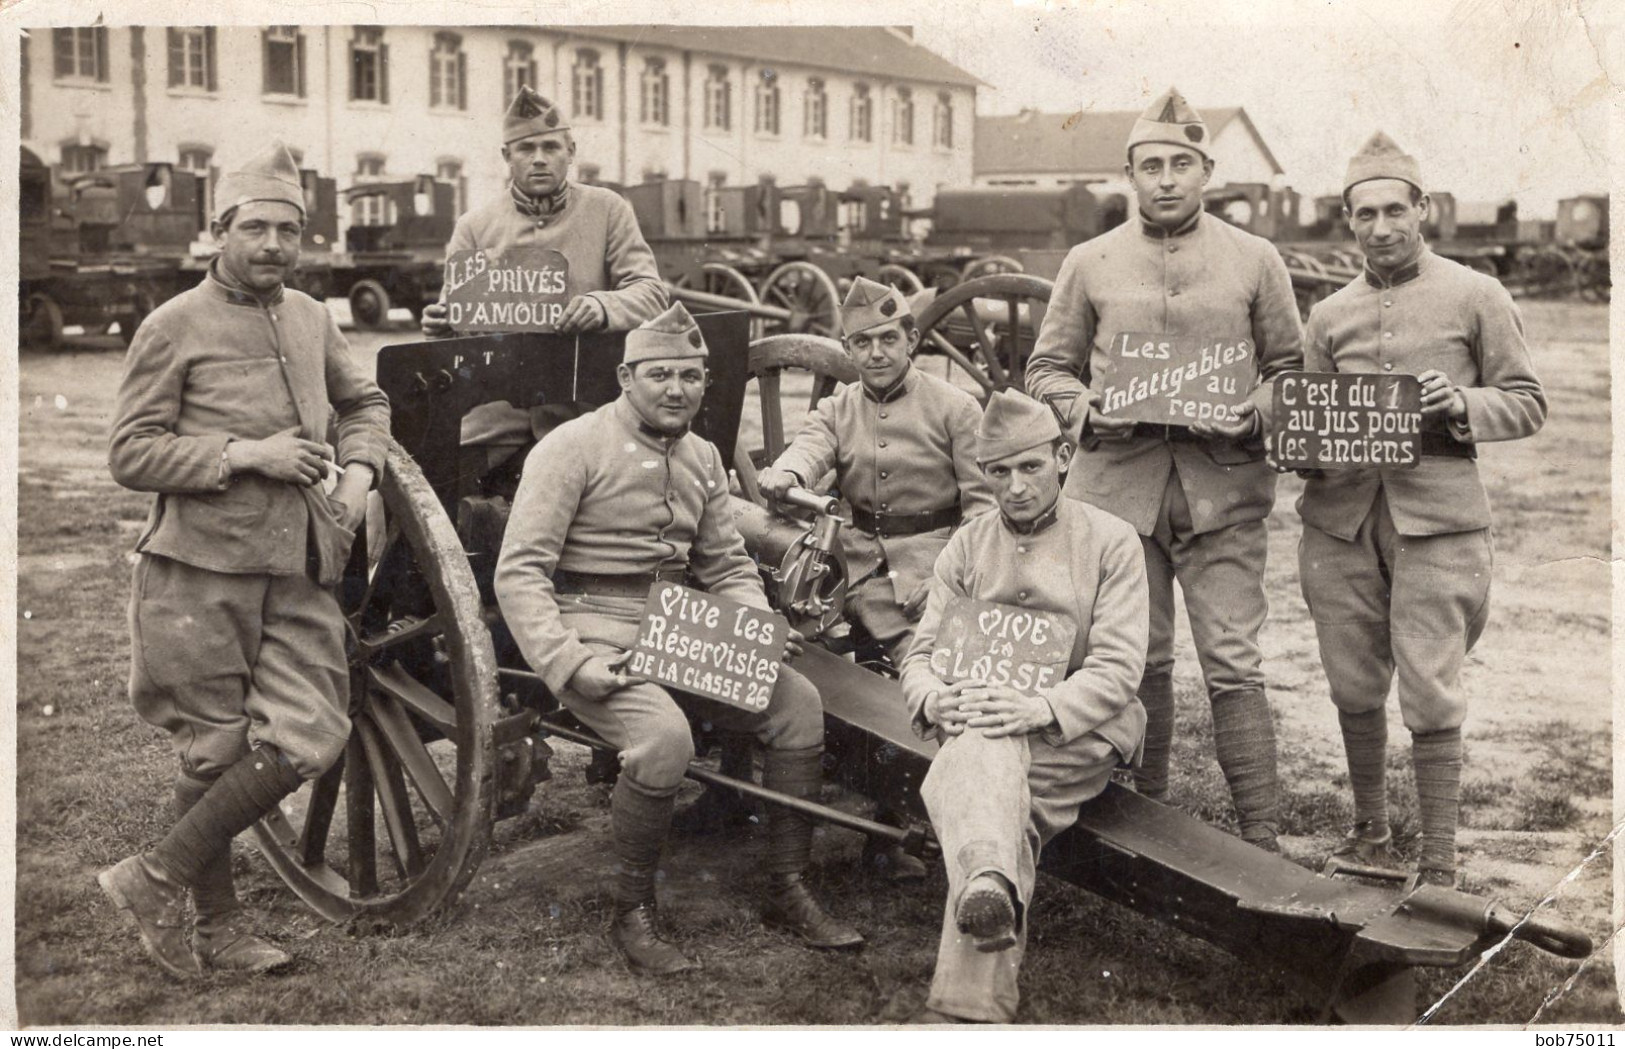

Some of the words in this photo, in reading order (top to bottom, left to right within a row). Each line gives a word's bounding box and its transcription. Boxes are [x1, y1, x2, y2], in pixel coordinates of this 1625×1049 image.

[449, 251, 486, 295] LES
[488, 265, 566, 294] PRIVÉS
[1121, 334, 1170, 359] Les
[1102, 341, 1248, 415] Infatigables
[1206, 375, 1236, 395] au
[1282, 378, 1339, 406] C'est
[1349, 377, 1376, 407] du
[1387, 381, 1400, 409] 1
[1169, 398, 1241, 422] repos
[1288, 410, 1315, 431] au
[1318, 406, 1360, 436] jus
[1367, 411, 1422, 438] pour
[1278, 431, 1308, 460] les
[1318, 435, 1414, 463] anciens
[660, 585, 720, 628] Vive
[733, 606, 775, 645] les
[978, 608, 1050, 645] VIVE
[640, 614, 780, 683] Réservistes
[988, 639, 1014, 657] LA
[630, 652, 655, 675] DE
[657, 659, 678, 682] LA
[683, 667, 742, 701] CLASSE
[745, 682, 770, 709] 26
[930, 648, 1054, 692] CLASSE
